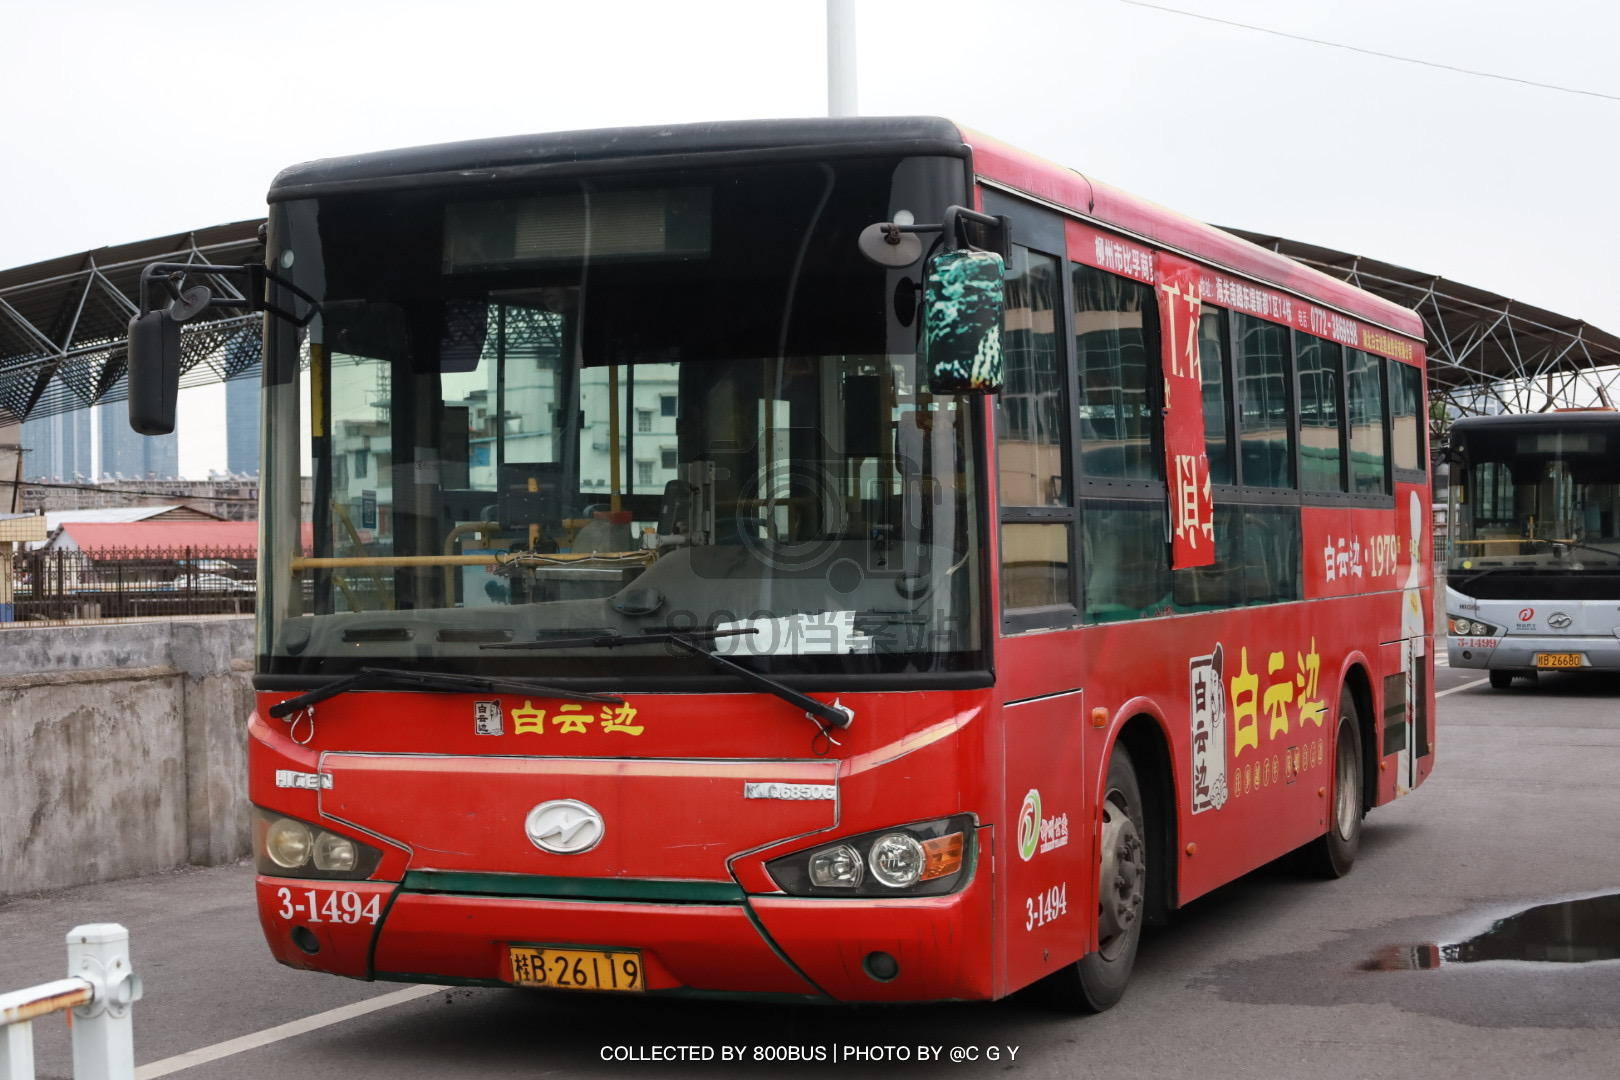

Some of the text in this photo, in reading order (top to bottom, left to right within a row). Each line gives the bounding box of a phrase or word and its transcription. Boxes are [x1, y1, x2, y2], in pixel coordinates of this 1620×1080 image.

[1457, 638, 1497, 648] 3-1499
[1231, 636, 1325, 757] 白云边
[477, 704, 488, 733] 白云边
[511, 700, 644, 736] 白云边
[1194, 671, 1210, 797] 白云边
[278, 887, 381, 925] 3-1494
[1026, 882, 1067, 931] 3-1494
